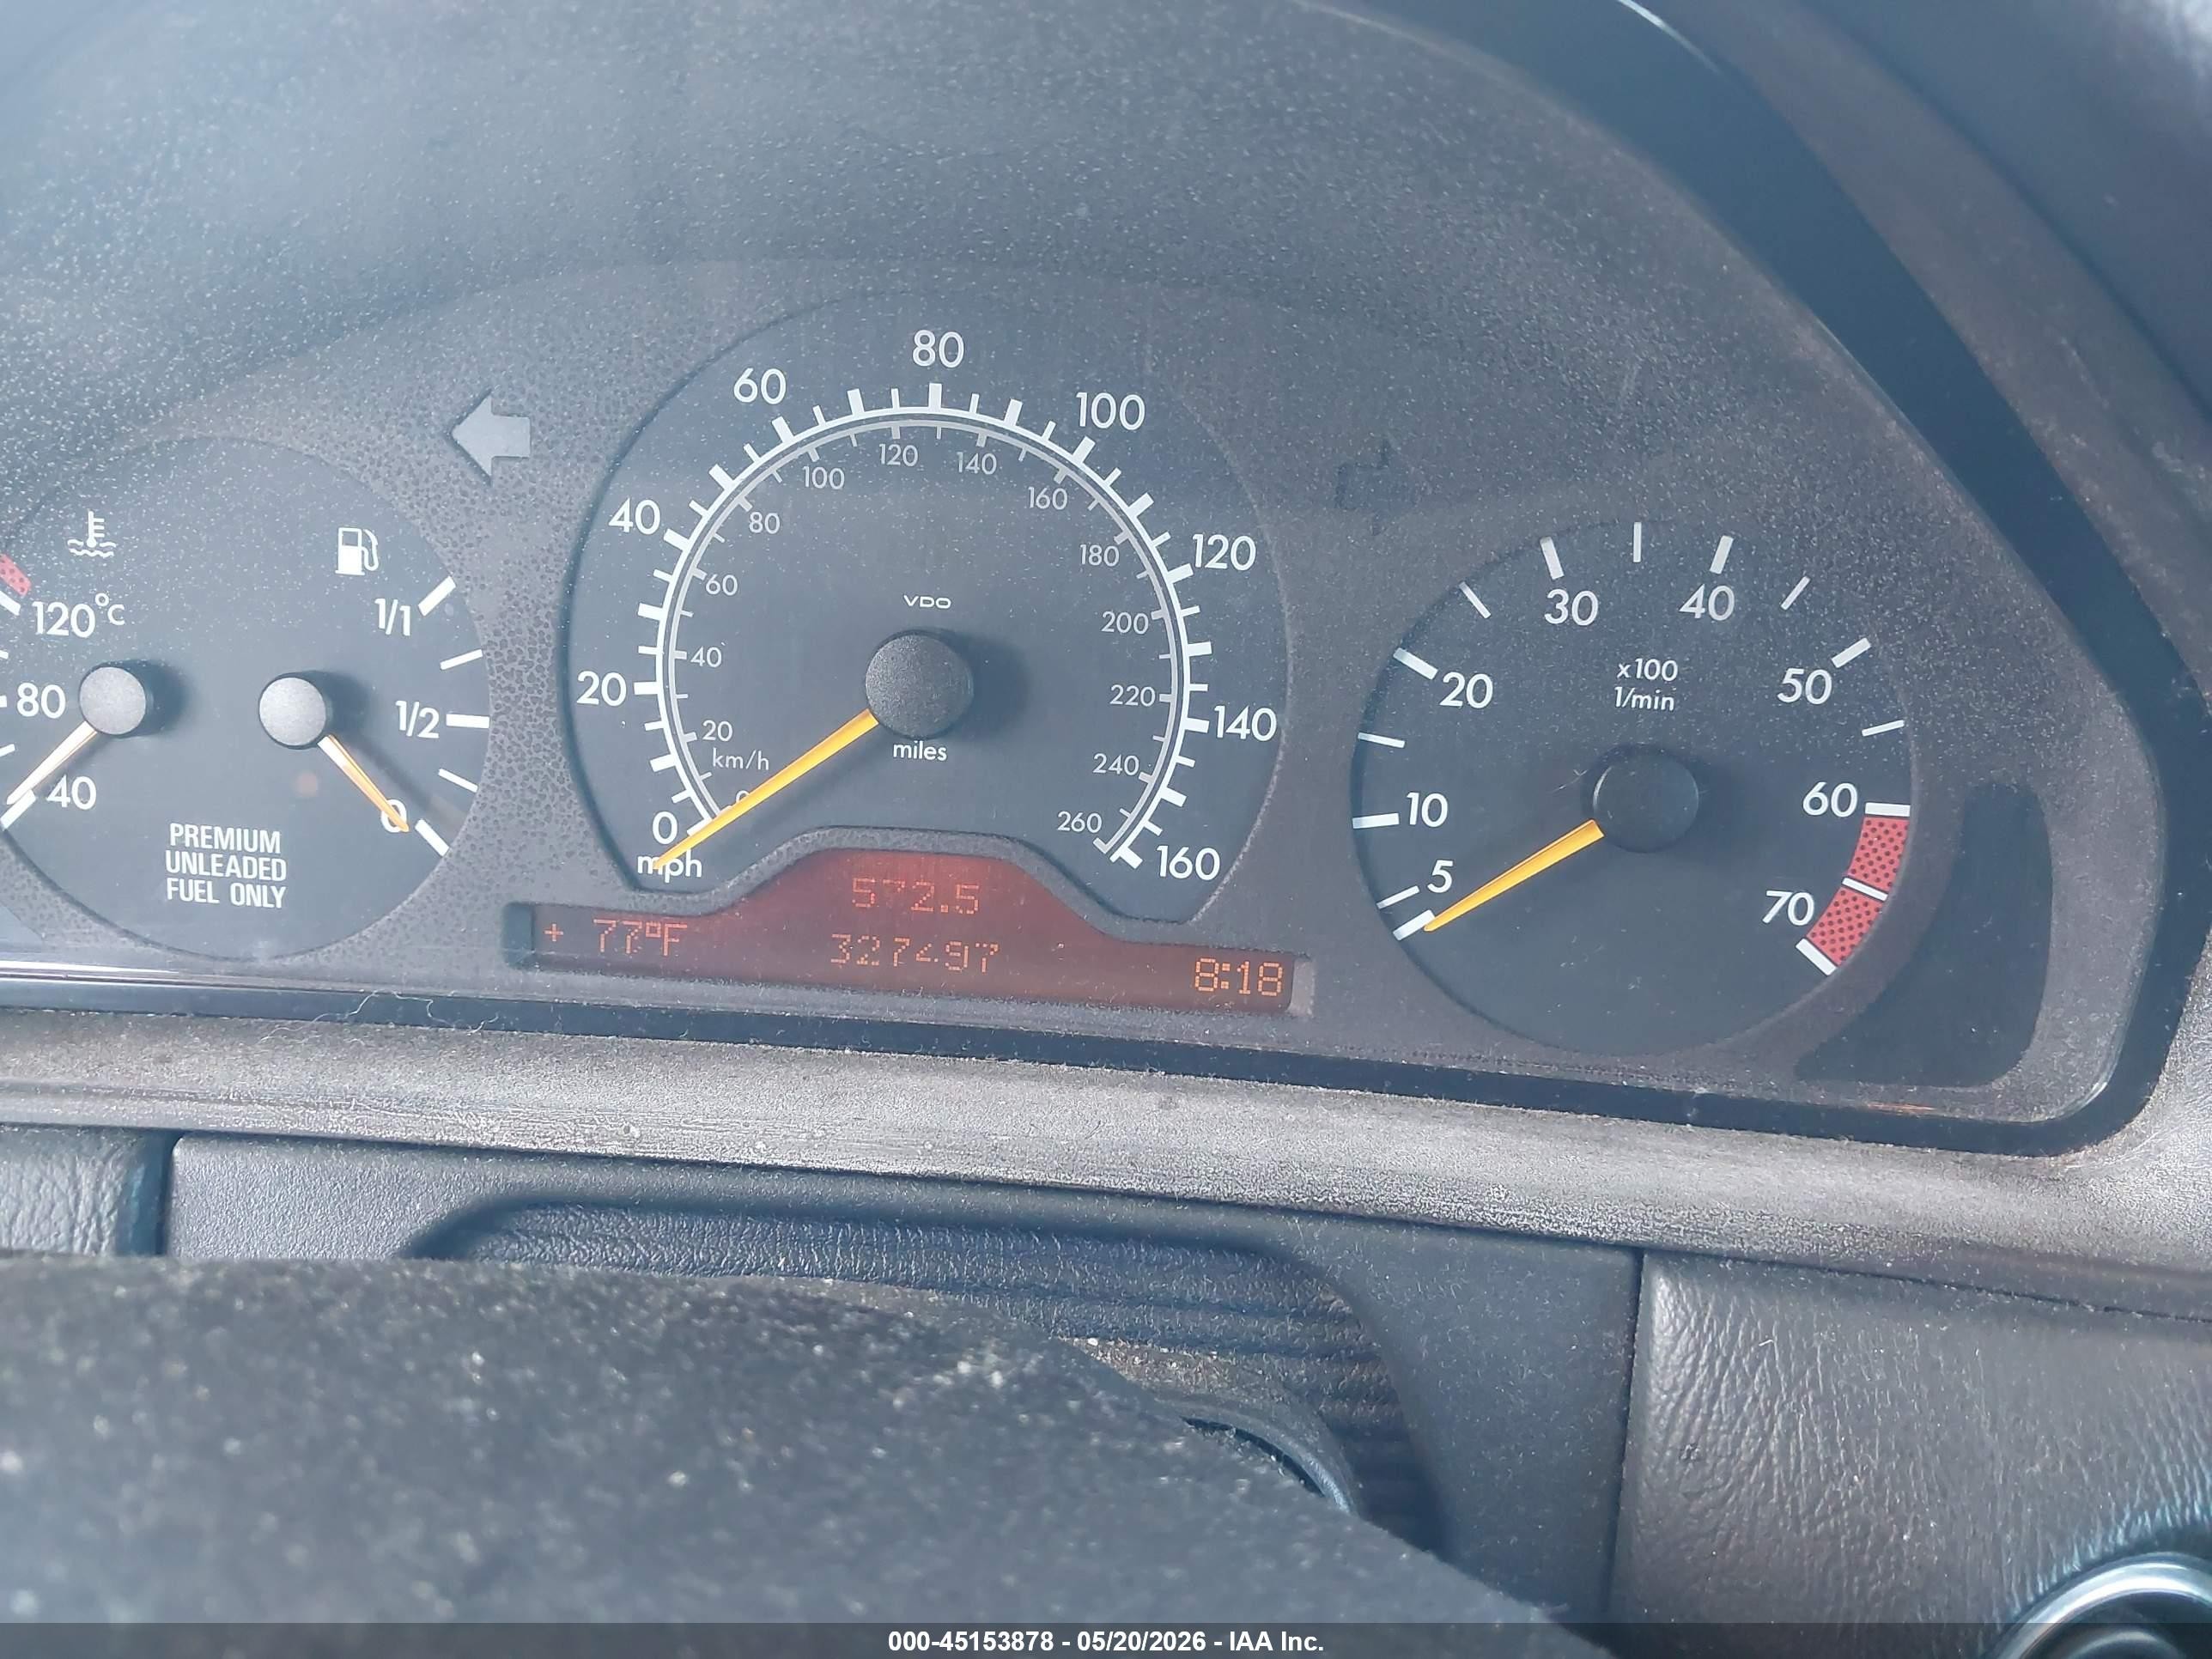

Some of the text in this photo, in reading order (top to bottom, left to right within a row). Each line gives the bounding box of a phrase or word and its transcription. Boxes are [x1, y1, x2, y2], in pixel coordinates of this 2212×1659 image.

[912, 330, 964, 368] 80
[733, 368, 787, 404] 60
[1076, 392, 1146, 430] 100
[879, 444, 918, 467] 120
[957, 452, 997, 475] 140
[803, 466, 845, 489] 100
[1029, 487, 1067, 510] 160
[608, 498, 660, 534] 40
[749, 512, 781, 534] 80
[1079, 544, 1120, 567] 180
[1192, 534, 1256, 570] 120
[705, 574, 738, 596] 60
[374, 598, 411, 636] 1/1
[904, 595, 951, 609] VDO
[1544, 589, 1598, 626] 30
[1679, 585, 1735, 622] 40
[1102, 612, 1149, 635] 200
[690, 647, 722, 667] 40
[1617, 659, 1678, 682] x100
[16, 683, 66, 719] 80
[577, 672, 626, 706] 20
[1109, 684, 1155, 707] 220
[1439, 672, 1493, 708] 20
[1613, 686, 1674, 711] 1/min
[1777, 669, 1832, 705] 50
[395, 701, 440, 738] 1/2
[702, 721, 732, 742] 20
[1213, 706, 1277, 741] 140
[713, 749, 769, 771] km/h
[892, 741, 946, 762] miles
[1093, 753, 1139, 775] 240
[47, 775, 96, 810] 40
[1802, 781, 1857, 817] 60
[380, 799, 407, 832] 0
[1057, 811, 1103, 833] 260
[1406, 792, 1448, 828] 10
[170, 823, 281, 854] PREMIUM
[653, 811, 678, 844] 0
[166, 851, 287, 881] UNLEADED
[637, 848, 702, 883] mph
[1157, 846, 1220, 880] 160
[1428, 860, 1453, 893] 5
[167, 878, 286, 908] FUEL ONLY
[853, 877, 980, 915] 572.5
[1762, 890, 1814, 926] 70
[1194, 957, 1284, 997] 8:18
